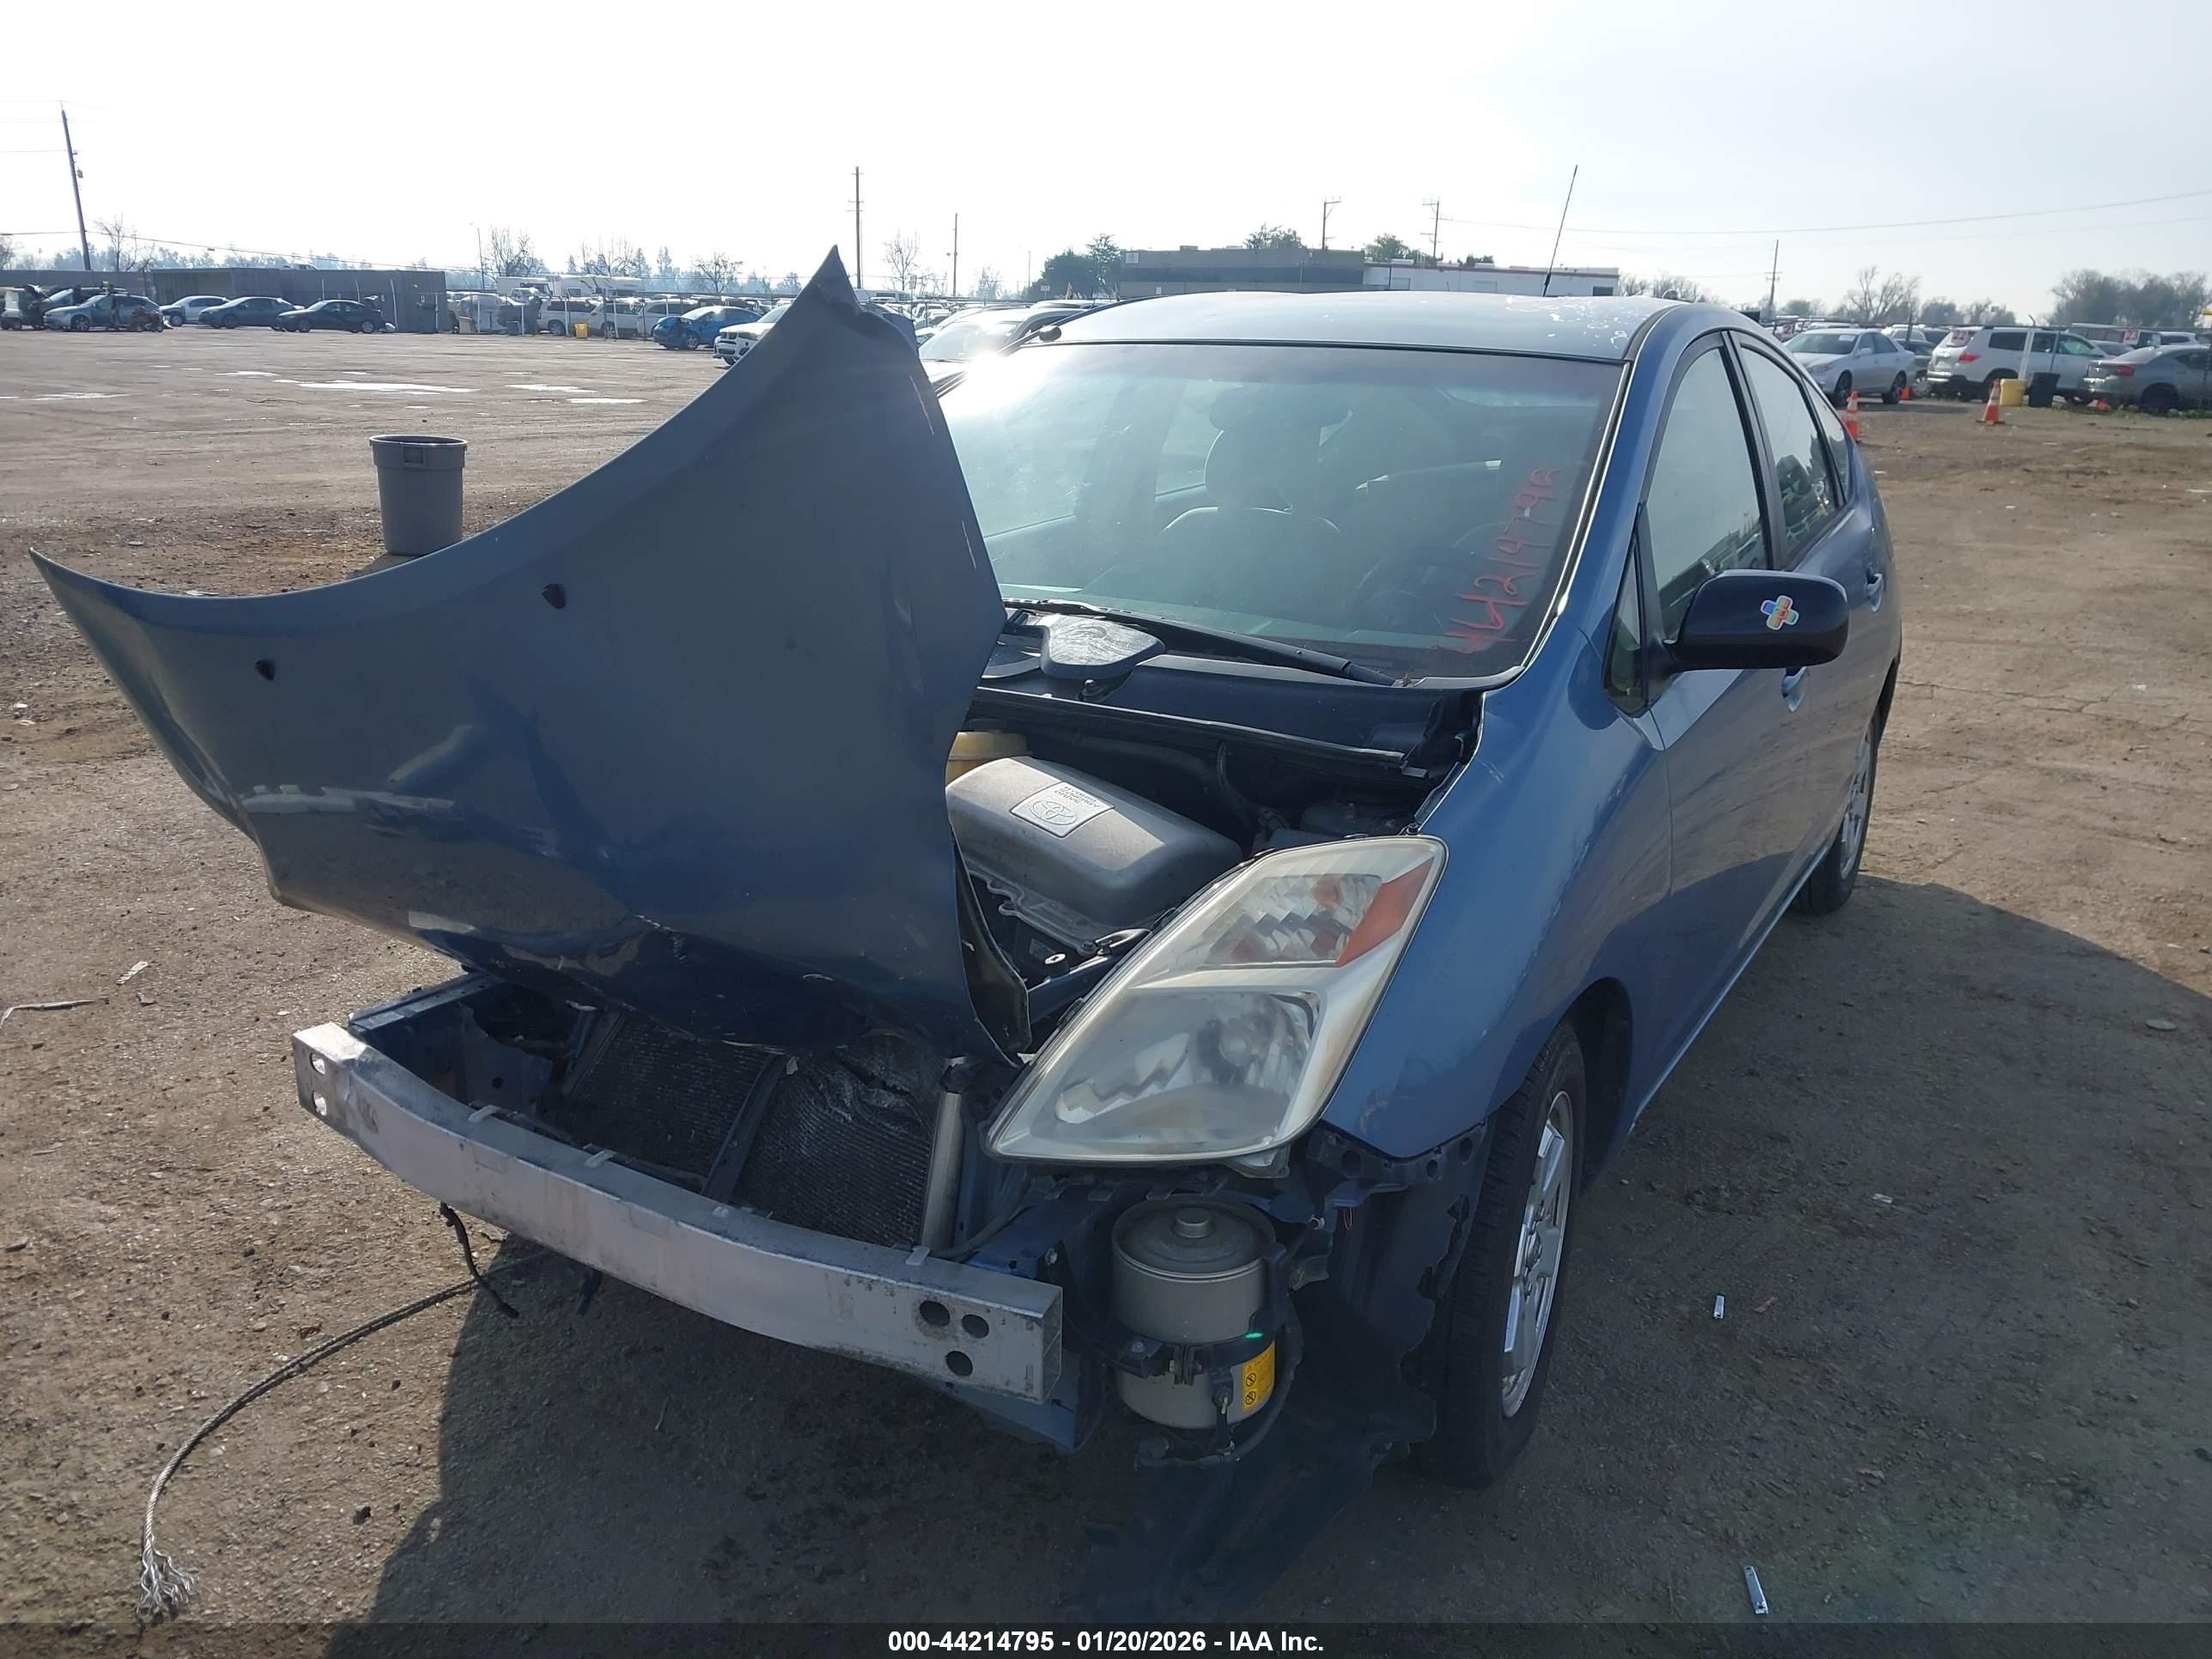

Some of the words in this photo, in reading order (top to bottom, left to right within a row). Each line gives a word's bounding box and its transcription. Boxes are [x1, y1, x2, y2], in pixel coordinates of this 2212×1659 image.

[1952, 329, 1966, 340] 22
[2124, 329, 2138, 340] 23
[1054, 790, 1081, 804] DRIVE
[1059, 788, 1100, 808] SYNERGY
[1064, 786, 1097, 803] HYBRID
